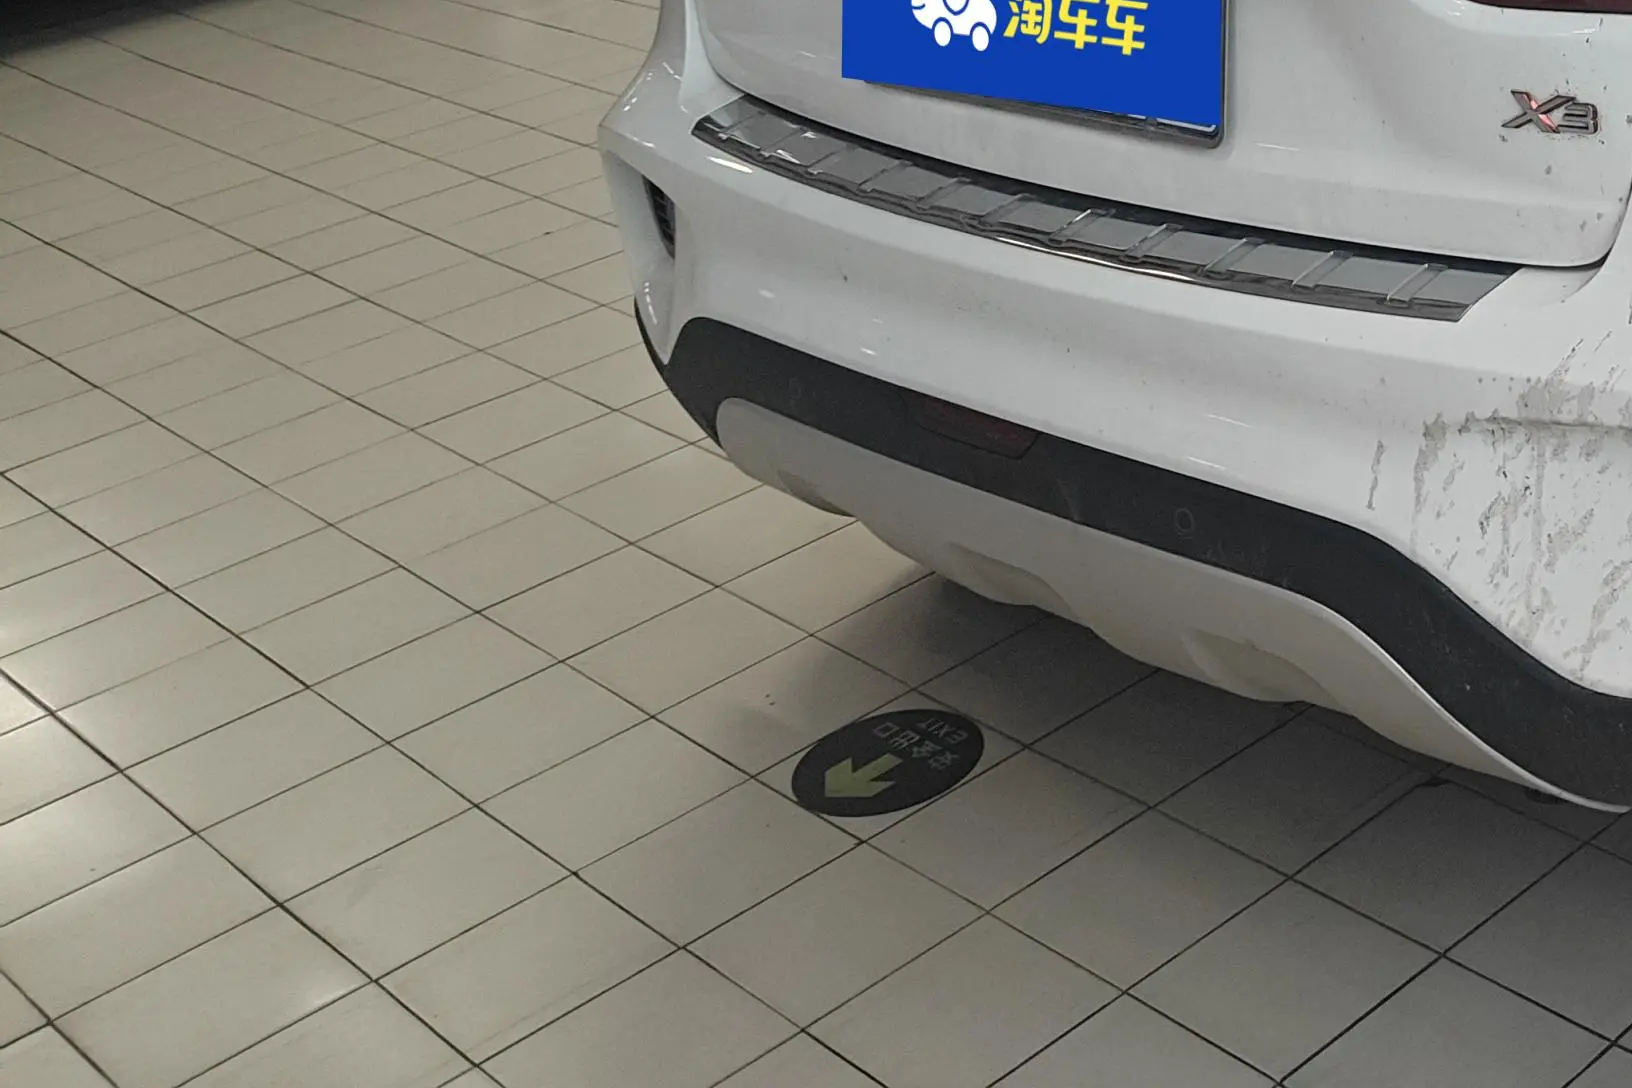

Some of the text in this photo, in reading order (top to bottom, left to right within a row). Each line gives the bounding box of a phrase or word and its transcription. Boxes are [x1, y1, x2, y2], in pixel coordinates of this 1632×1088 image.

[1501, 88, 1599, 135] X3
[872, 721, 961, 770] 安全出口
[915, 717, 970, 745] EXIT
